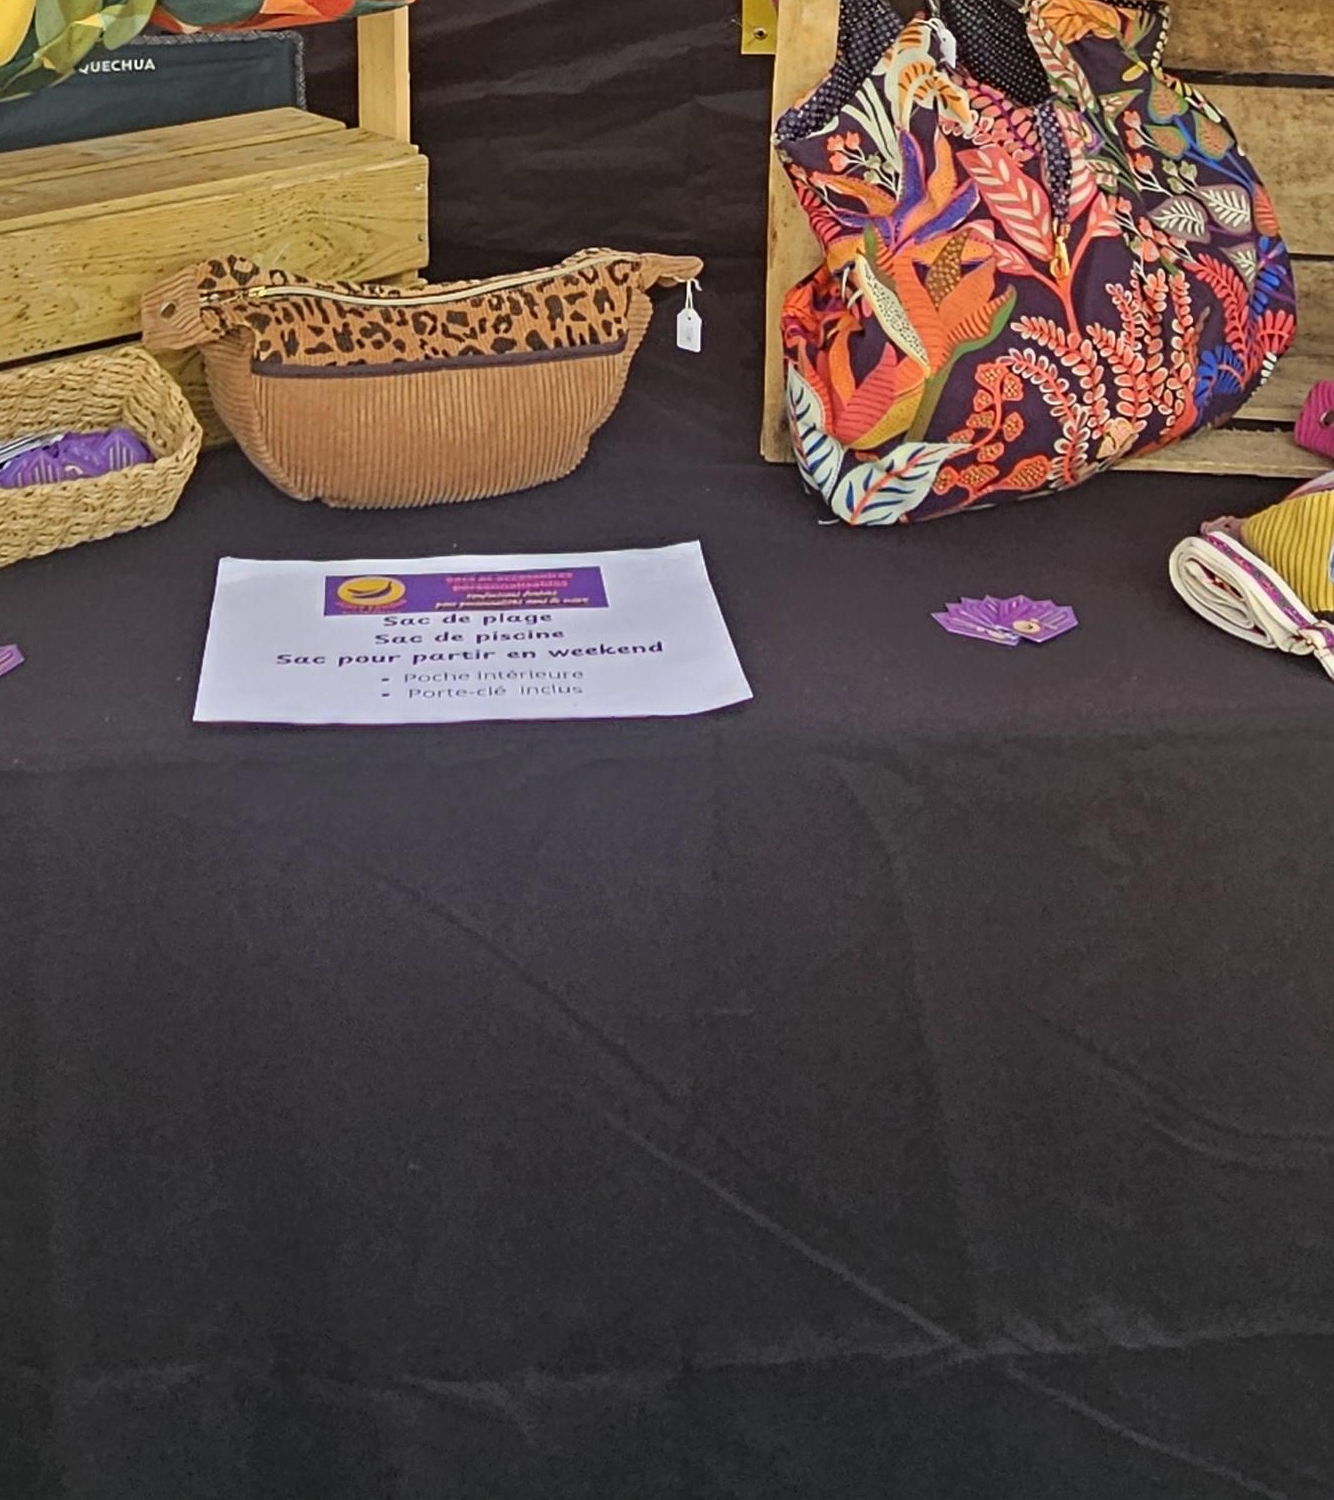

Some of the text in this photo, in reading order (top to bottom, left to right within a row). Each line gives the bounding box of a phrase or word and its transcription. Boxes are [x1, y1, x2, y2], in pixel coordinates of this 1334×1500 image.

[384, 612, 553, 627] Sac de plage
[375, 630, 565, 645] Sac de piscine
[277, 641, 664, 667] Sac pour partir en weekend
[404, 670, 585, 683] Poche intérieure
[409, 683, 584, 699] Porte-clé inclus
